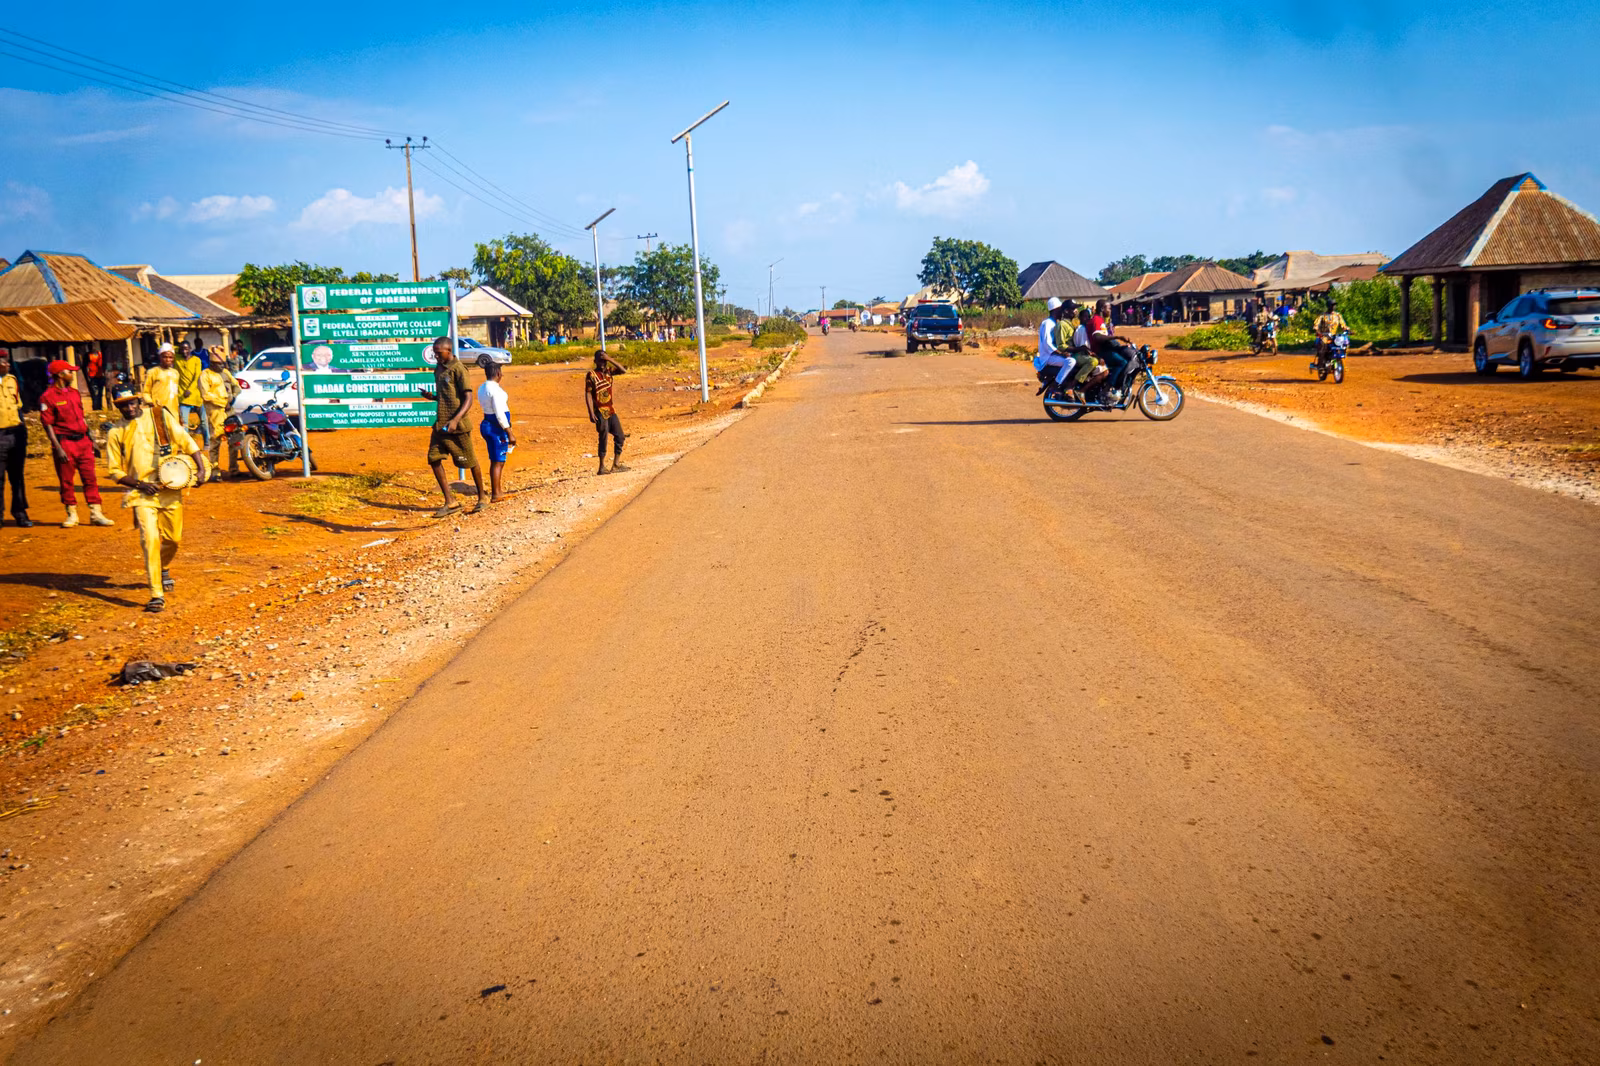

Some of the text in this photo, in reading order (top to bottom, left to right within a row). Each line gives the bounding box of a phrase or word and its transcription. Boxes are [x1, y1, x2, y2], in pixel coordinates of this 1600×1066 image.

[330, 287, 446, 296] FEDERAL GOVERNMENT
[346, 383, 409, 393] CONSTRUCTION
